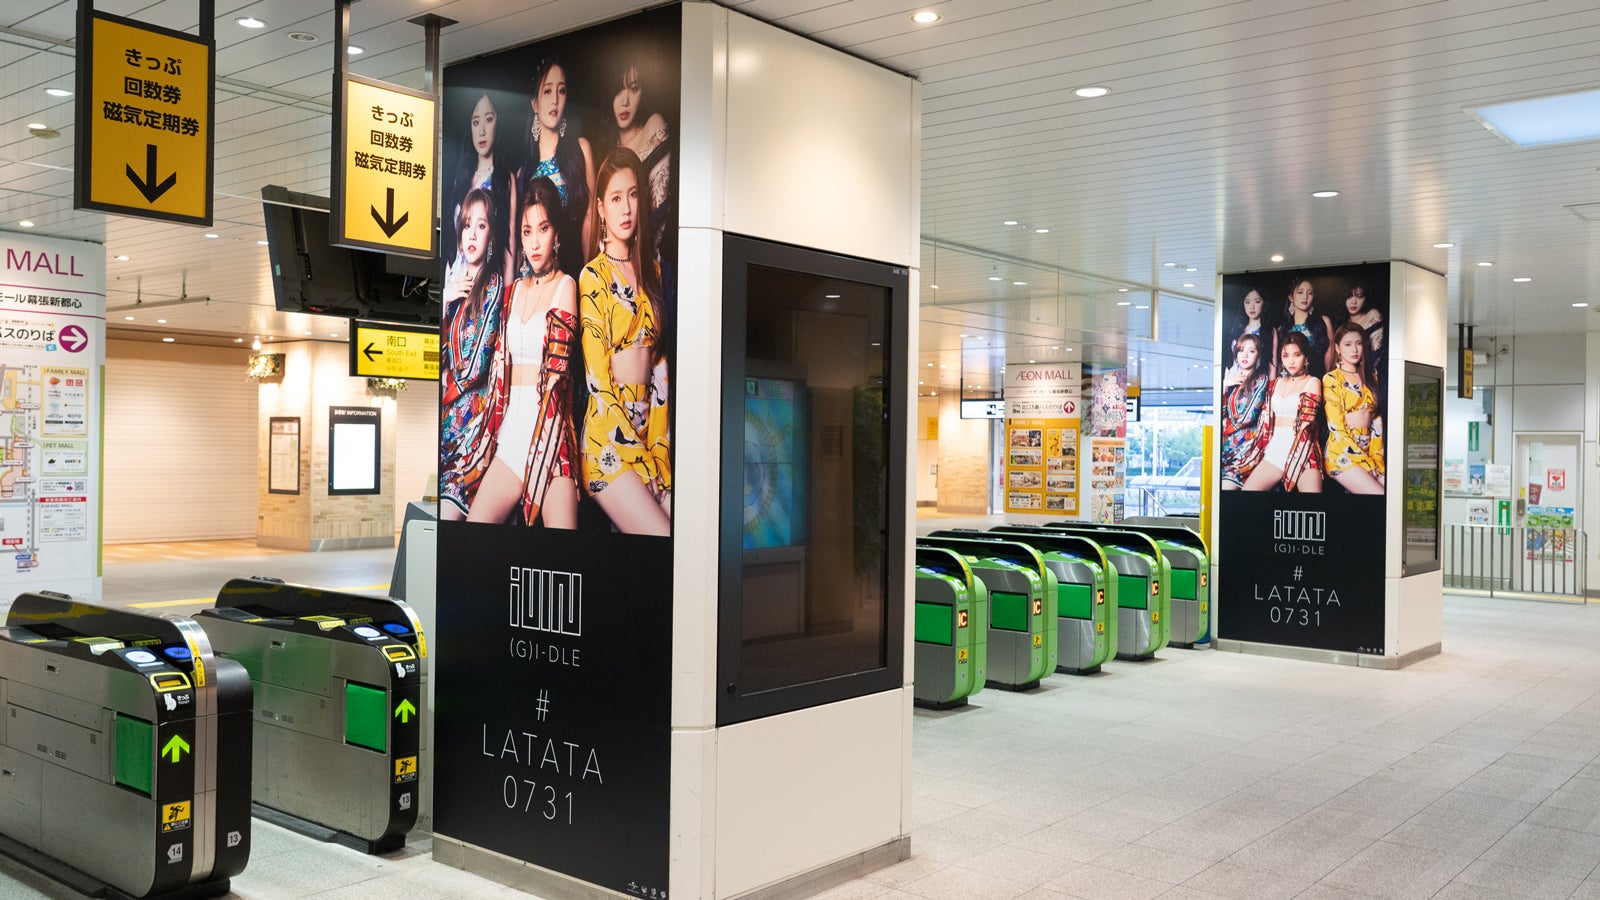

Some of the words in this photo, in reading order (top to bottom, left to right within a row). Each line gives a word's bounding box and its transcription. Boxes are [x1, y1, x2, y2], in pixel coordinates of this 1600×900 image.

[125, 48, 182, 76] きっぷ
[124, 77, 182, 105] 回数券
[102, 101, 200, 137] 磁気定期券
[371, 105, 414, 128] きっぷ
[370, 130, 413, 153] 回数券
[354, 151, 427, 180] 磁気定期券
[7, 248, 84, 277] MALL
[0, 327, 56, 342] スのりば
[386, 335, 407, 348] 南口
[1045, 369, 1074, 380] MALL
[1273, 543, 1326, 556] (G)I-DLE
[1293, 565, 1304, 581] #
[1253, 583, 1342, 607] LATATA
[958, 610, 968, 628] IC
[1033, 600, 1042, 615] IC
[1269, 605, 1321, 627] 0731
[510, 637, 581, 667] (G)I-DLE
[535, 688, 551, 722] #
[482, 723, 604, 784] LATATA
[401, 795, 411, 805] 13
[503, 774, 574, 825] 0731
[229, 833, 239, 844] 13
[171, 847, 182, 856] 14
